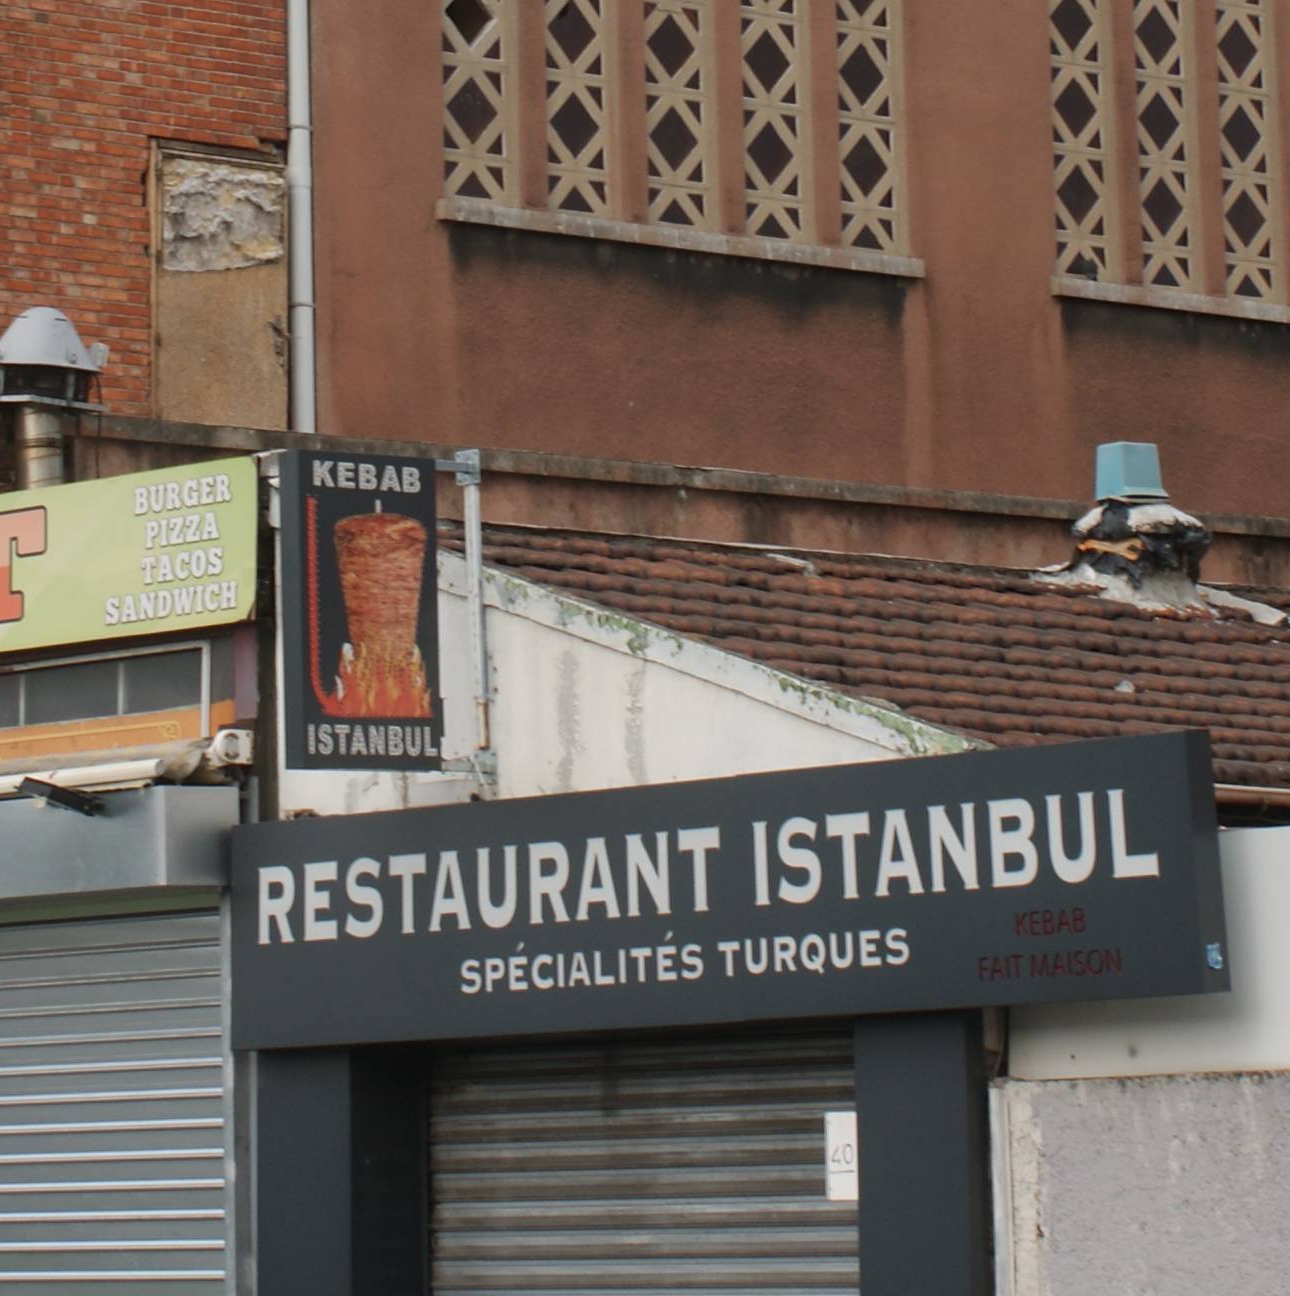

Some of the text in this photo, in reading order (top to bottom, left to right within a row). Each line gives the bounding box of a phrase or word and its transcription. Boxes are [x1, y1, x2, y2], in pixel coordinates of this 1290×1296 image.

[134, 474, 231, 516] BURGER
[312, 459, 421, 494] KEBAB
[145, 512, 220, 549] PIZZA
[142, 547, 223, 585] TACOS
[105, 581, 238, 626] SANDWICH
[308, 723, 437, 756] ISTANBUL
[258, 788, 1160, 944] RESTAURANT ISTANBUL
[1014, 907, 1086, 936] KEBAB
[461, 927, 909, 994] SPÉCIALITÉS TURQUES
[978, 947, 1122, 981] FAIT MAISON
